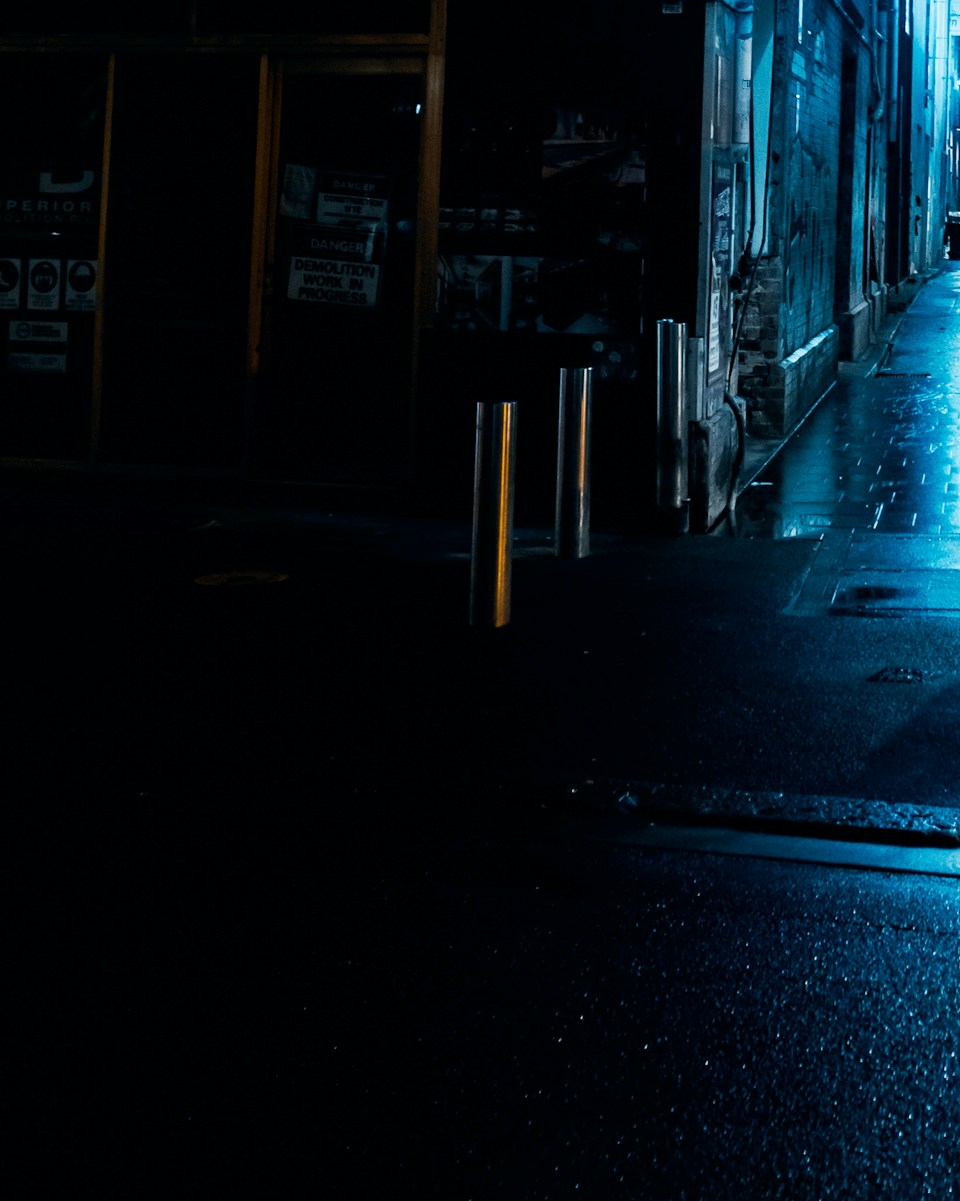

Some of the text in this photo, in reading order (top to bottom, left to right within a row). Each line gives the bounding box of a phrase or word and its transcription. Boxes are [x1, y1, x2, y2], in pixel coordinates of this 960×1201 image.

[332, 179, 376, 192] DANGER
[0, 199, 91, 212] PERIOR
[310, 237, 365, 254] DANGER
[294, 259, 376, 278] DEMOLITION
[303, 273, 364, 290] WORK IN
[298, 287, 367, 305] PROGRESS
